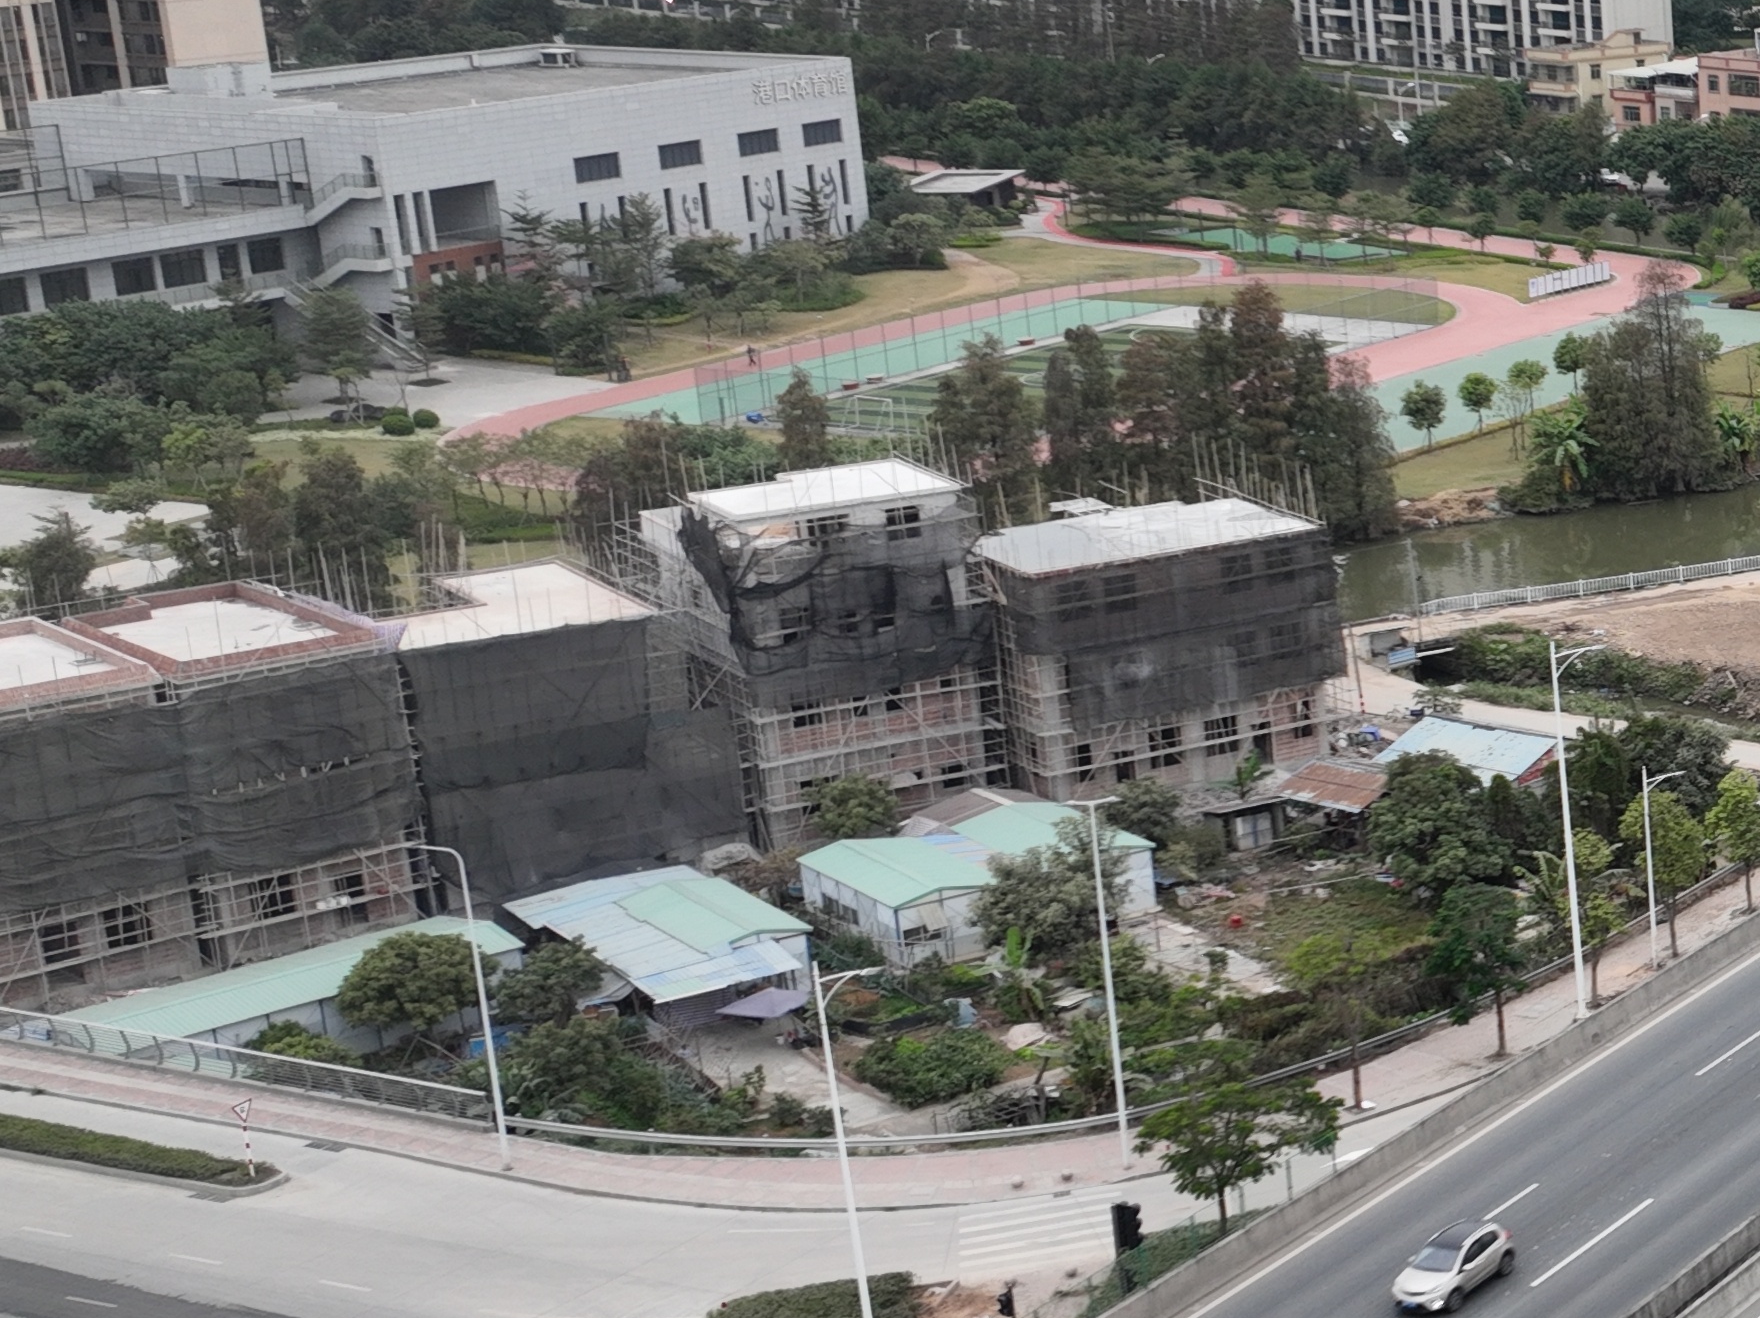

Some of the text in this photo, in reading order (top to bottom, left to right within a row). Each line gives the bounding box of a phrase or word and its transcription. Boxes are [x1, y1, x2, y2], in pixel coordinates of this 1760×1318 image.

[752, 70, 847, 105] 港口体育馆
